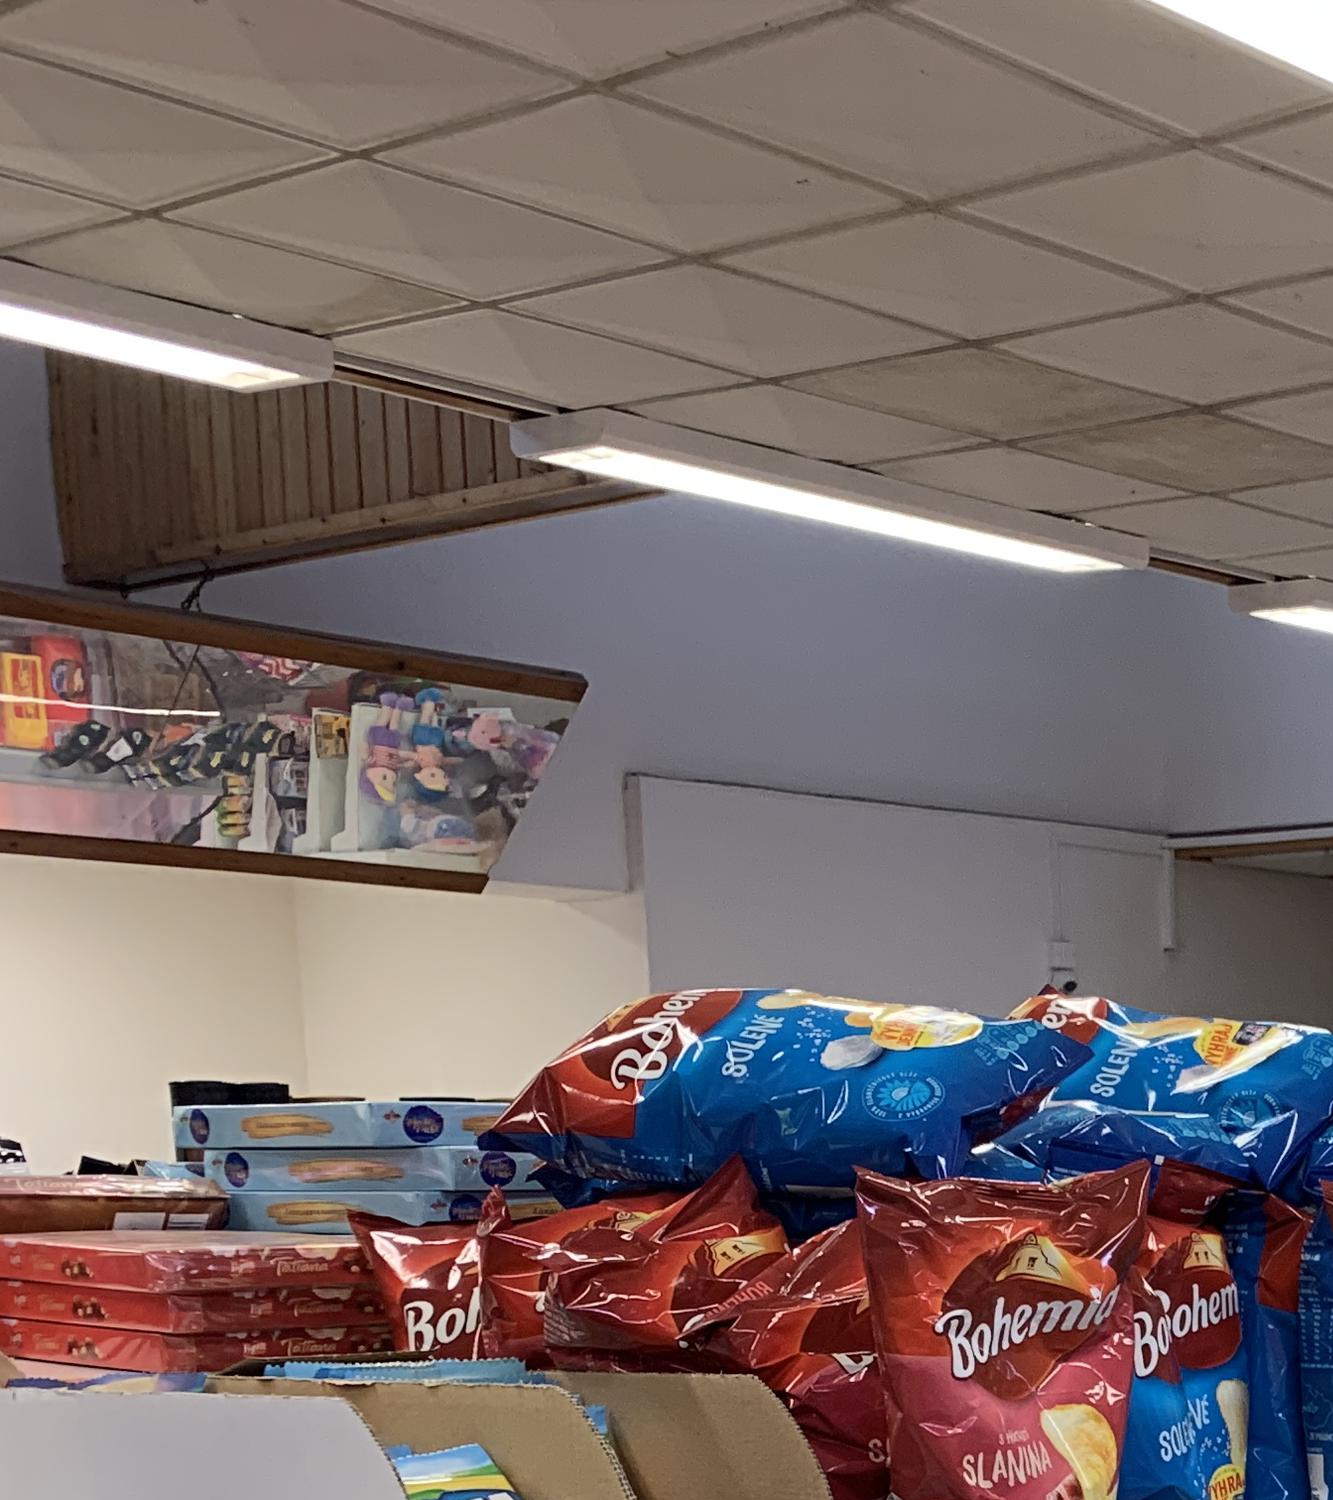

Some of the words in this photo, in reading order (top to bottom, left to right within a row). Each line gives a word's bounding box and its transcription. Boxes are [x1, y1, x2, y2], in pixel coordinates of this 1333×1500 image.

[721, 1013, 785, 1079] SOLENÉ
[935, 1283, 1122, 1380] Bohemia
[961, 1440, 1053, 1490] SLANINA
